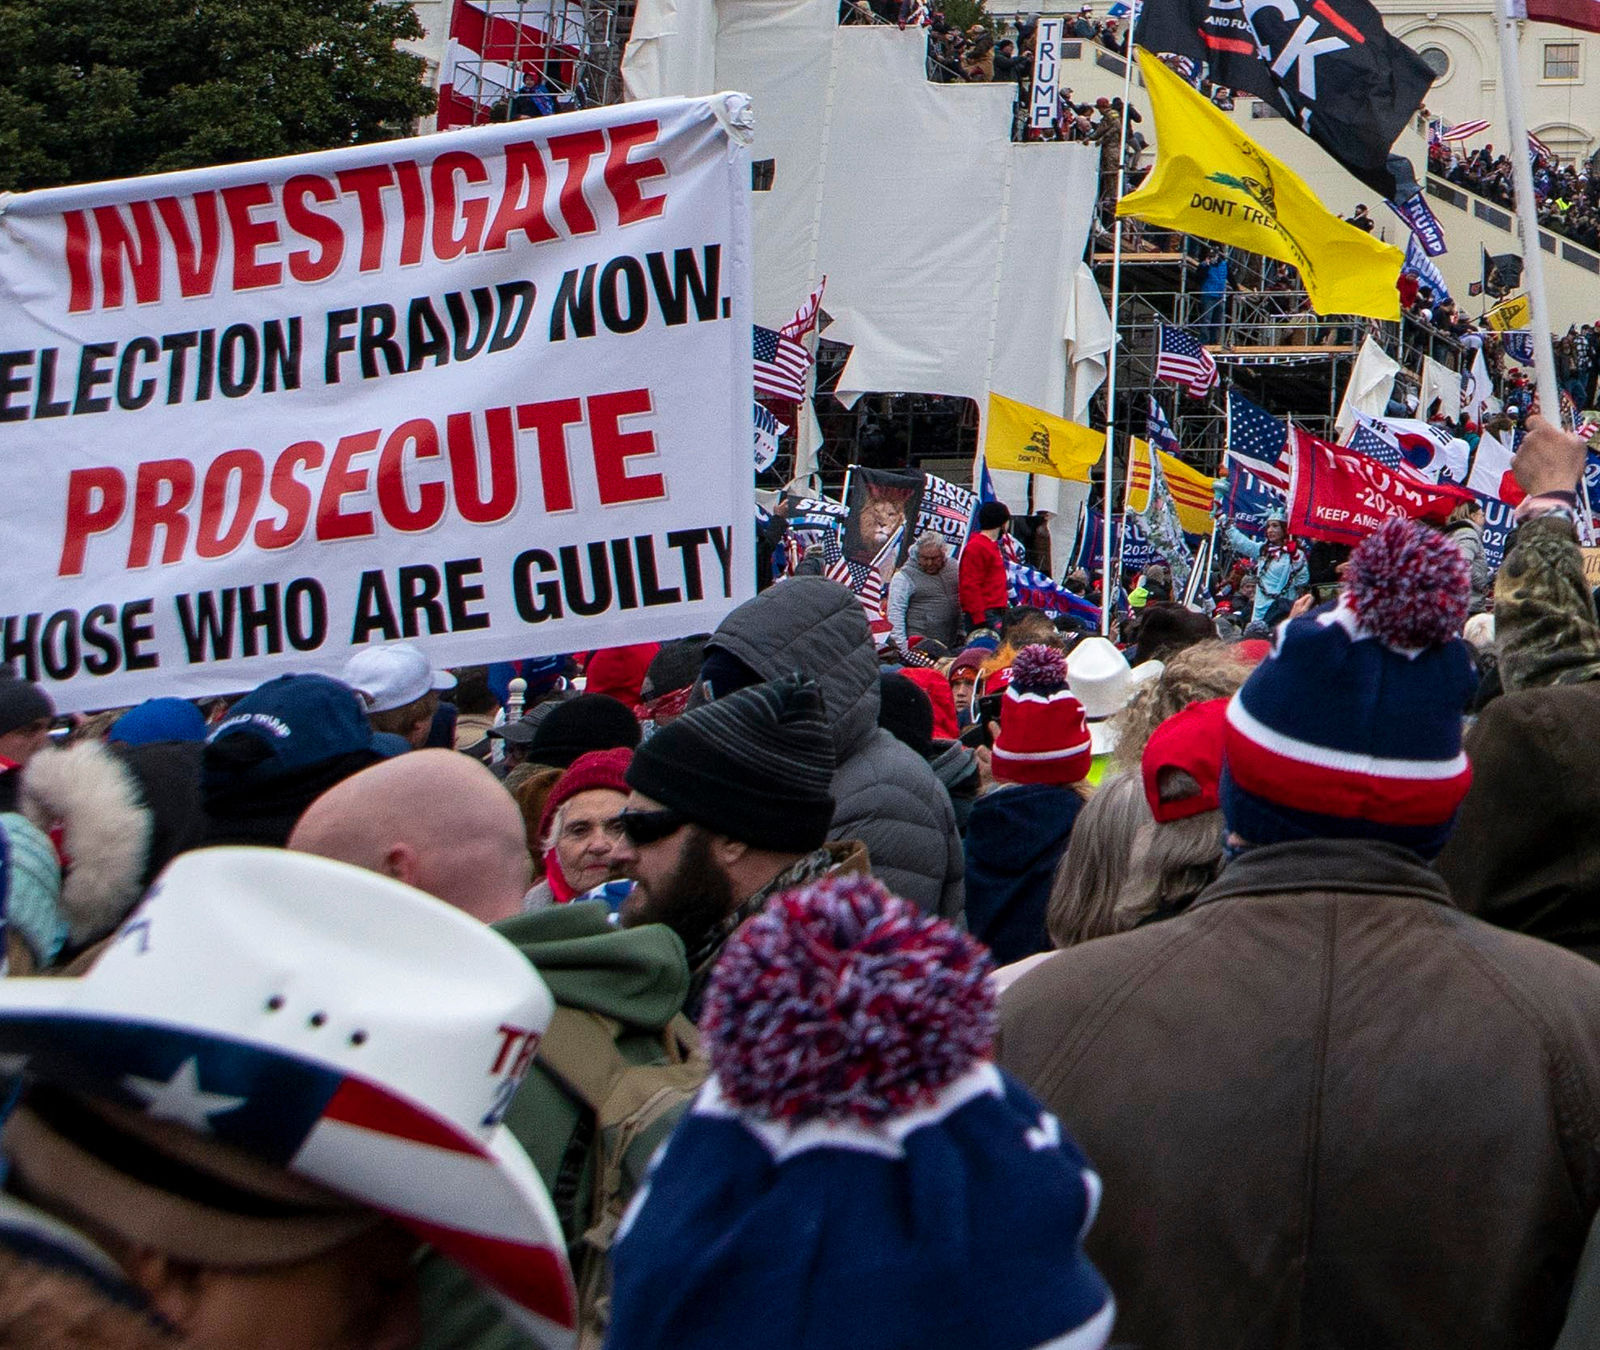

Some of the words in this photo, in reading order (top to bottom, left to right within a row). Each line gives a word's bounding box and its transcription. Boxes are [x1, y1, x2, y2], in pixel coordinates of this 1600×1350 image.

[1205, 15, 1230, 28] AND
[1231, 19, 1254, 34] FUC
[1034, 22, 1058, 126] TRUMP
[63, 118, 668, 314] INVESTIGATE
[1191, 193, 1237, 217] DONT
[1408, 194, 1441, 252] TRUMP
[0, 315, 301, 421] ELECTION
[325, 280, 536, 384] FRAUD
[549, 244, 731, 342] NOW.
[58, 389, 667, 575] PROSECUTE
[933, 493, 949, 506] MY
[805, 513, 835, 525] THE
[1235, 511, 1257, 525] KEEP
[1316, 506, 1350, 525] KEEP
[0, 598, 158, 683] HOSE
[176, 578, 328, 663] WHO
[352, 557, 490, 645] ARE
[512, 525, 734, 623] GUILTY
[253, 712, 292, 738] TRUMP
